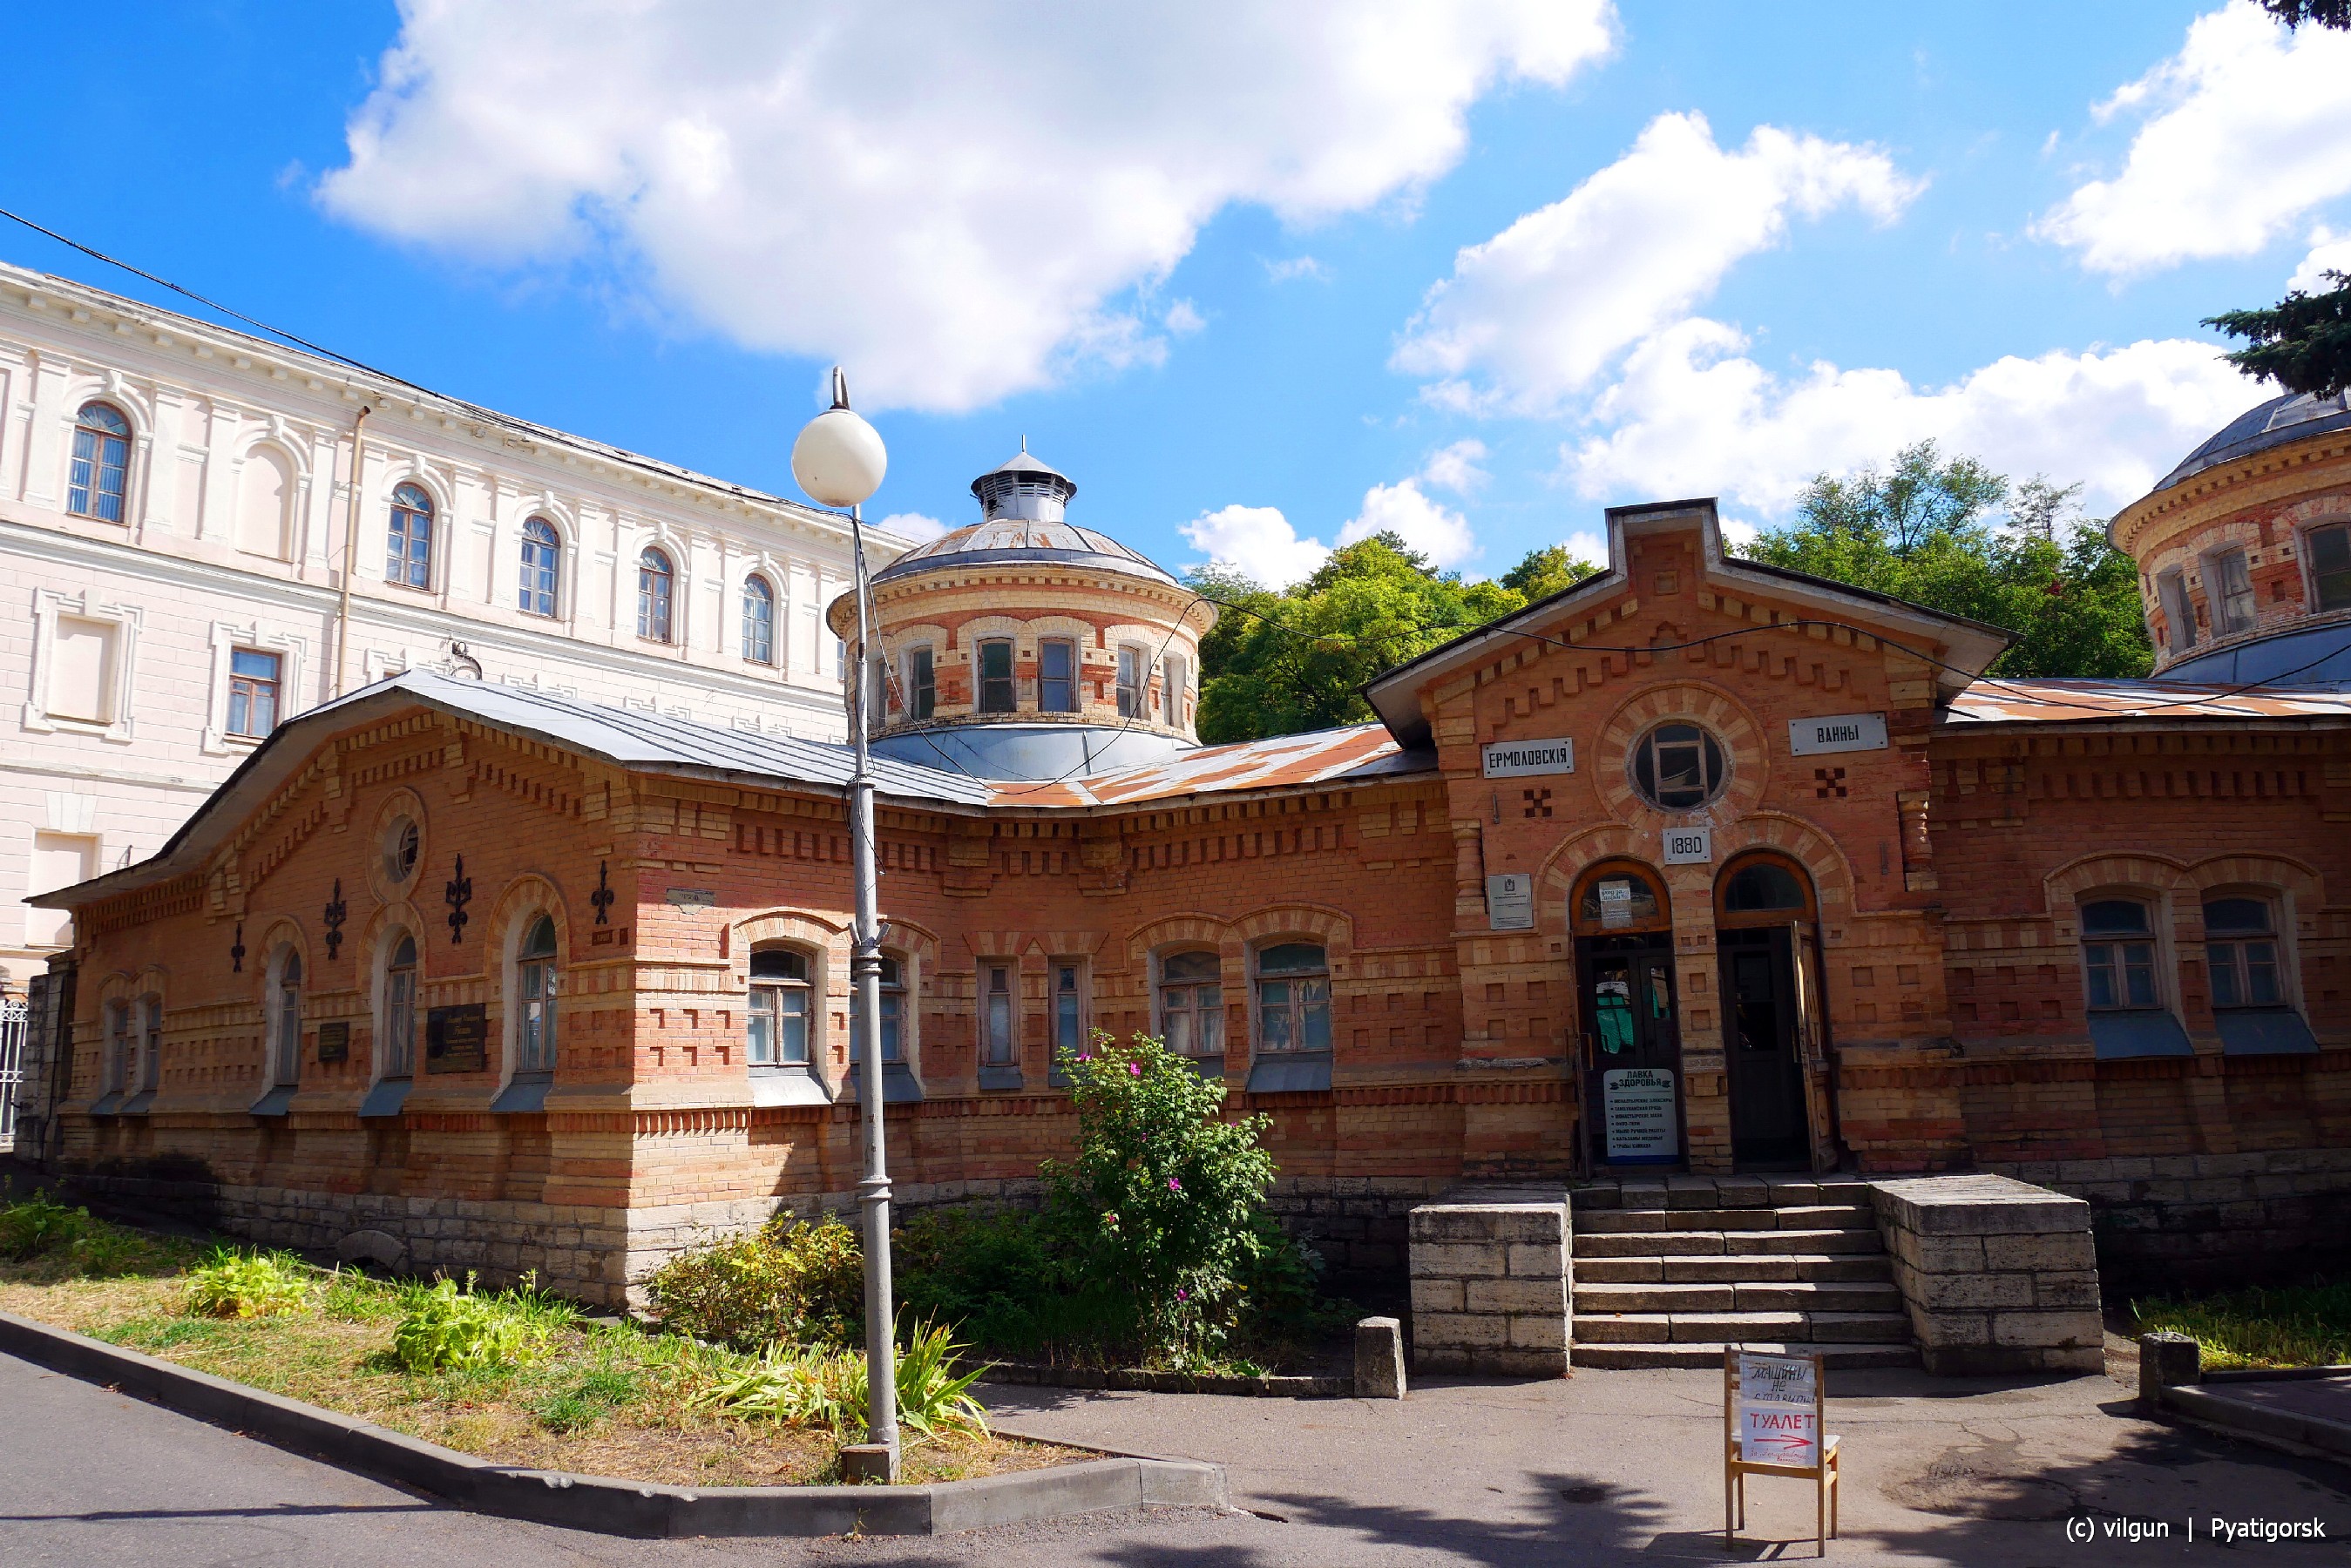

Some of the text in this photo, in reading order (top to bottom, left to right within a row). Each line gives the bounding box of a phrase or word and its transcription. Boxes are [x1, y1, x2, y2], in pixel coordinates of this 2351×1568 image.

[1816, 724, 1860, 744] ВАННЫ
[1488, 747, 1568, 768] ЕРМОЛОВСКІЯ
[1671, 836, 1703, 855] 1880
[1619, 1078, 1663, 1088] ЗДОРОВЬЯ
[1627, 1070, 1654, 1079] ЛАВКА
[1750, 1413, 1816, 1429] ТУАЛЕТ
